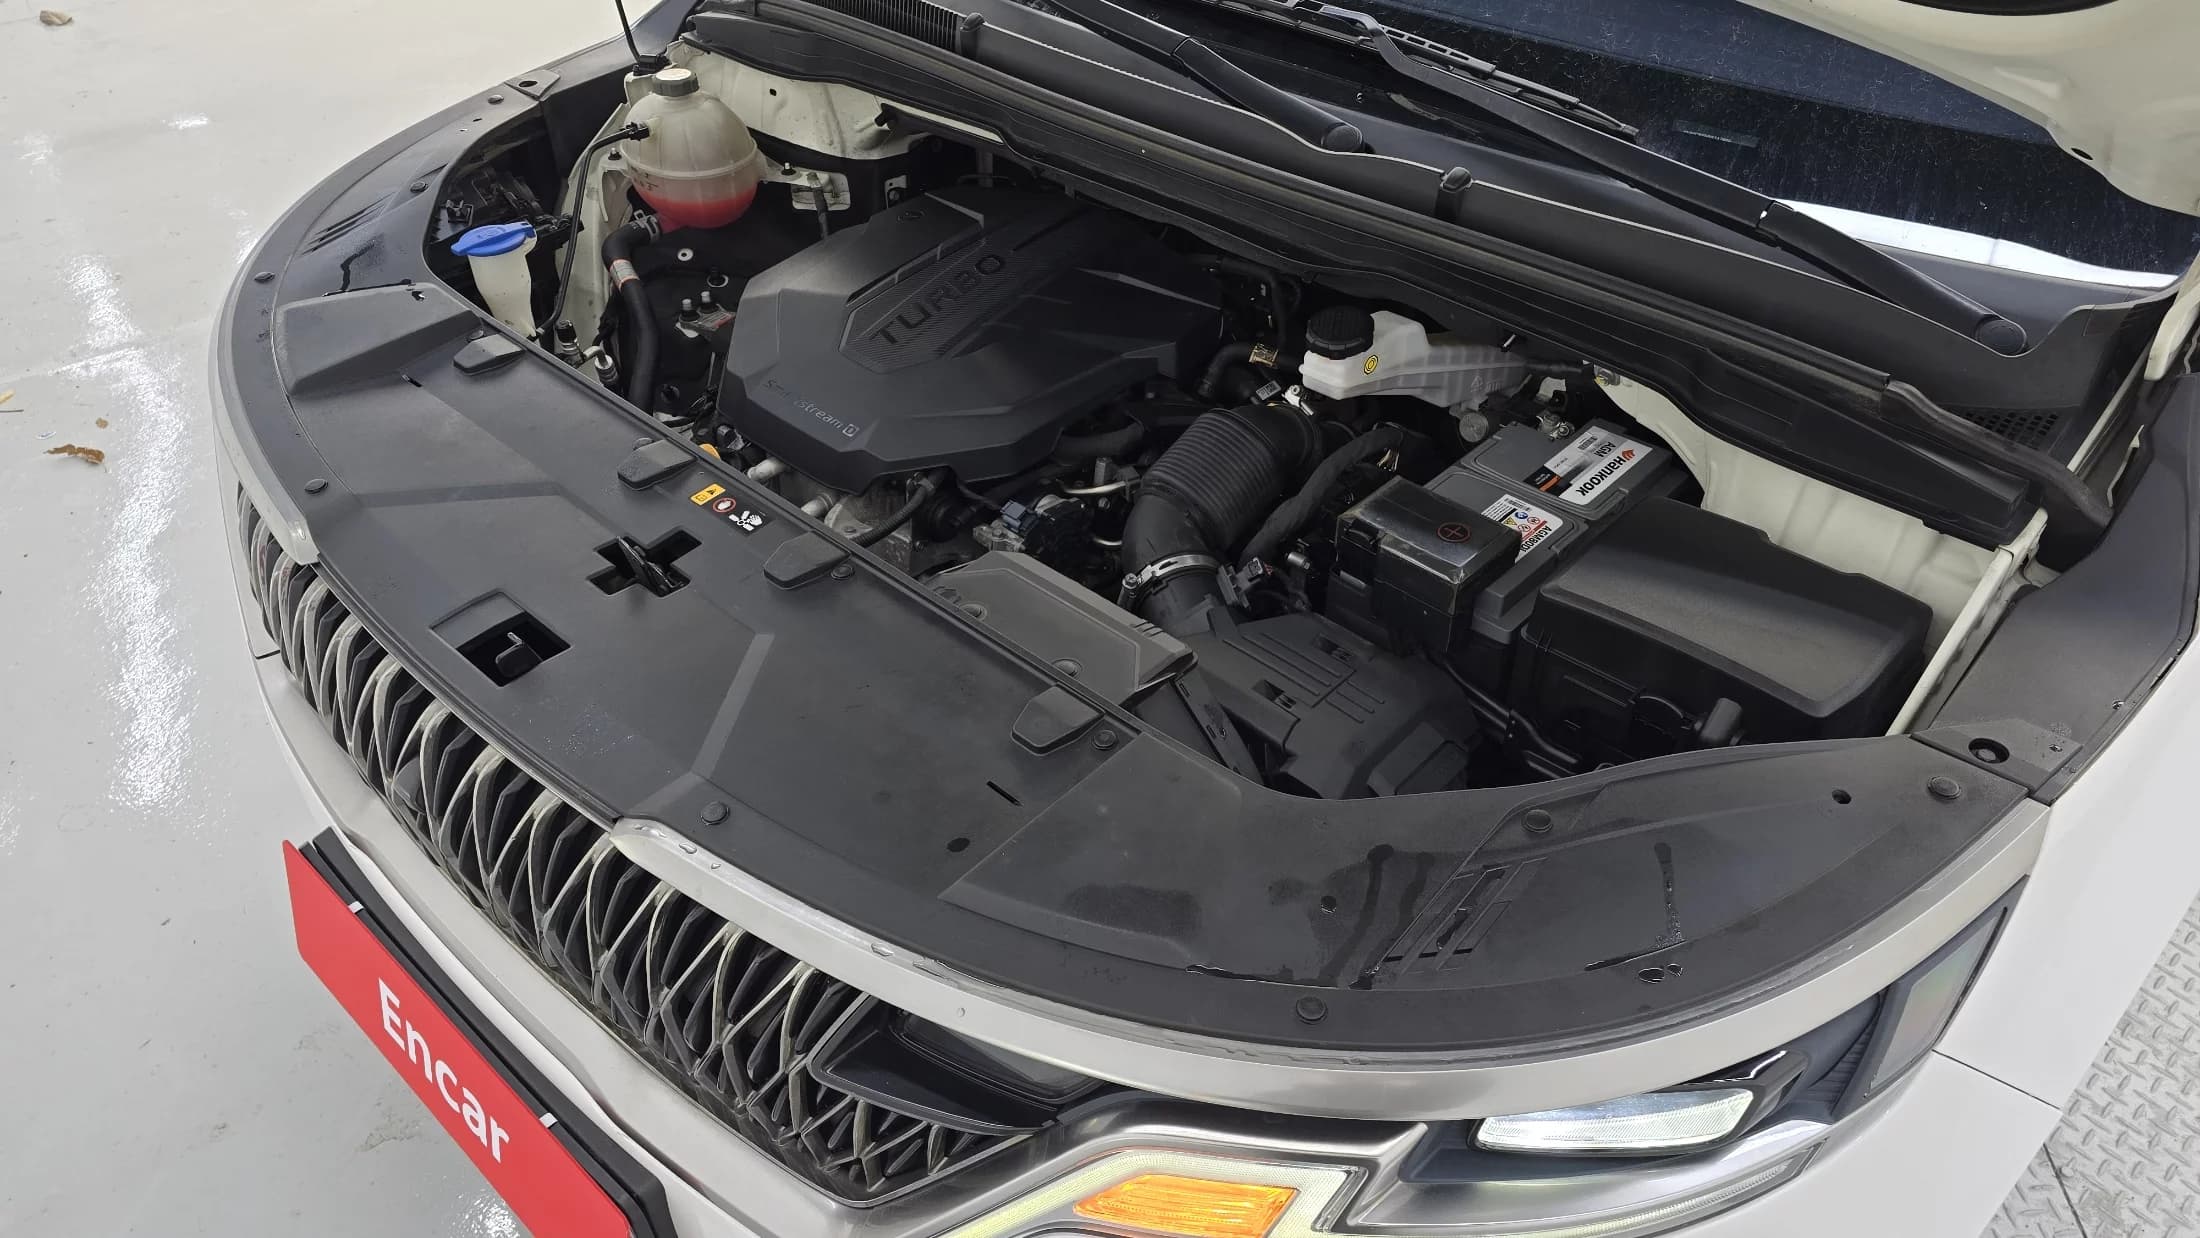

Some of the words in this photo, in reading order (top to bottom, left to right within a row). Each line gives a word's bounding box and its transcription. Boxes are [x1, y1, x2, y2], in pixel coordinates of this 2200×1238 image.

[869, 255, 1006, 345] TURBO
[1593, 441, 1617, 458] AGM
[378, 976, 511, 1164] Encar
